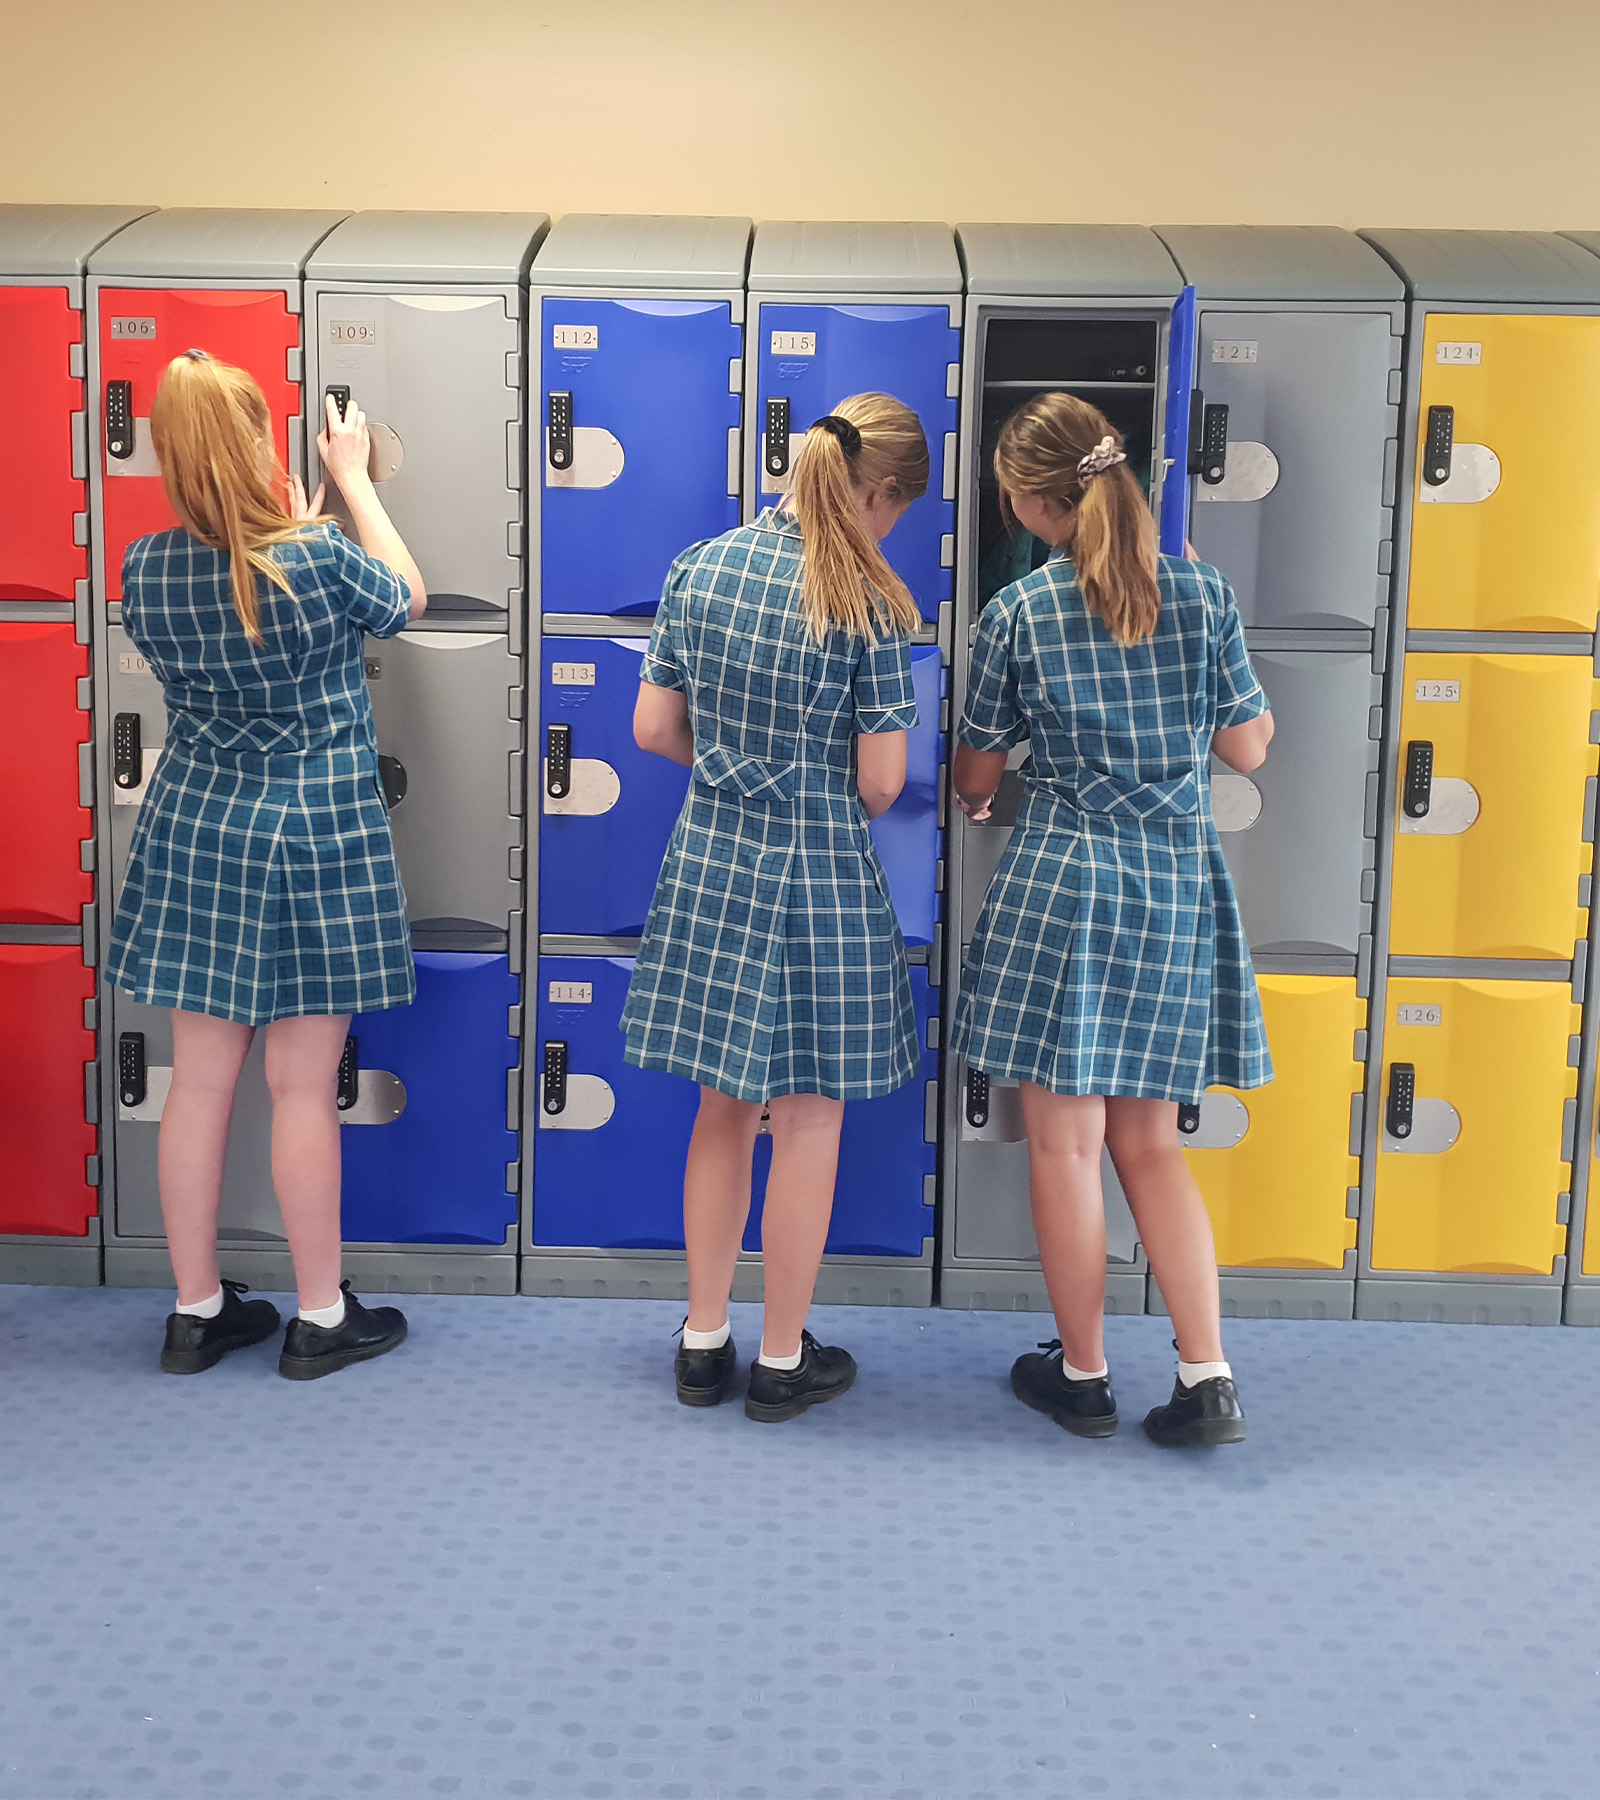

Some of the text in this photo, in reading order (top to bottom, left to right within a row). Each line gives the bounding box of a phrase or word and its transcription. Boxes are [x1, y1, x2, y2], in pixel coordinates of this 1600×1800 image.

[118, 322, 149, 334] 106
[336, 326, 367, 339] 109
[561, 331, 592, 345] 112
[779, 336, 809, 349] 115
[1220, 346, 1251, 359] 121
[1443, 346, 1473, 359] 124
[126, 658, 145, 670] 10
[559, 667, 589, 681] 113
[1421, 685, 1453, 698] 125
[556, 986, 585, 999] 114
[1404, 1009, 1435, 1022] 126
